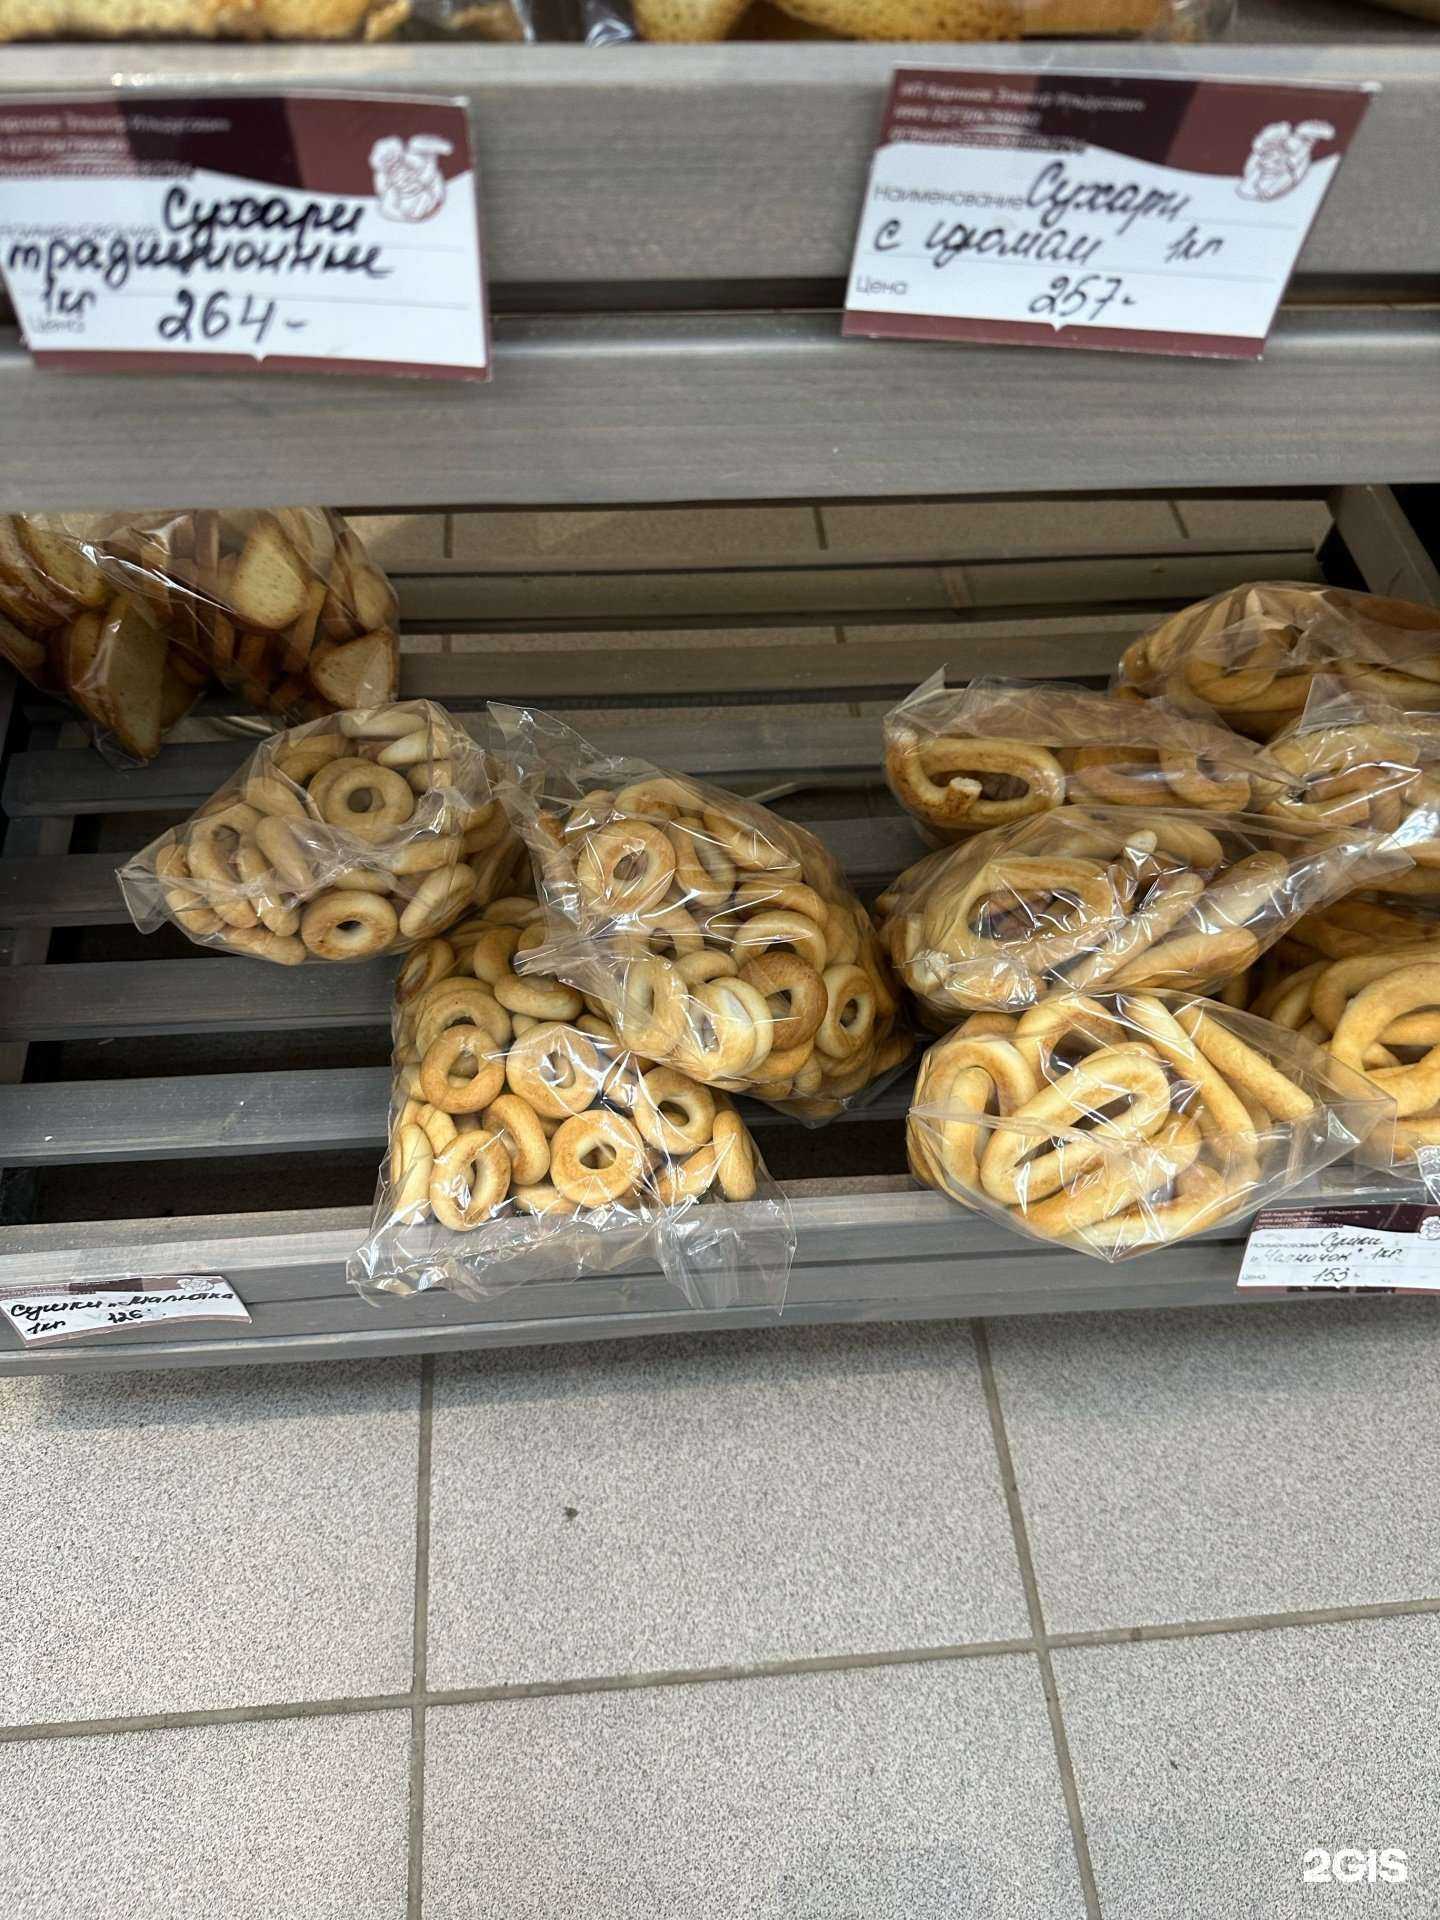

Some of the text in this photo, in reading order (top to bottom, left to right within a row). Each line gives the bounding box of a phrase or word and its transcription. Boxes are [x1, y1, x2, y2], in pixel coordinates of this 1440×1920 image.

[873, 184, 1024, 210] Наименование
[163, 186, 365, 241] Сухари
[856, 276, 908, 297] Цена
